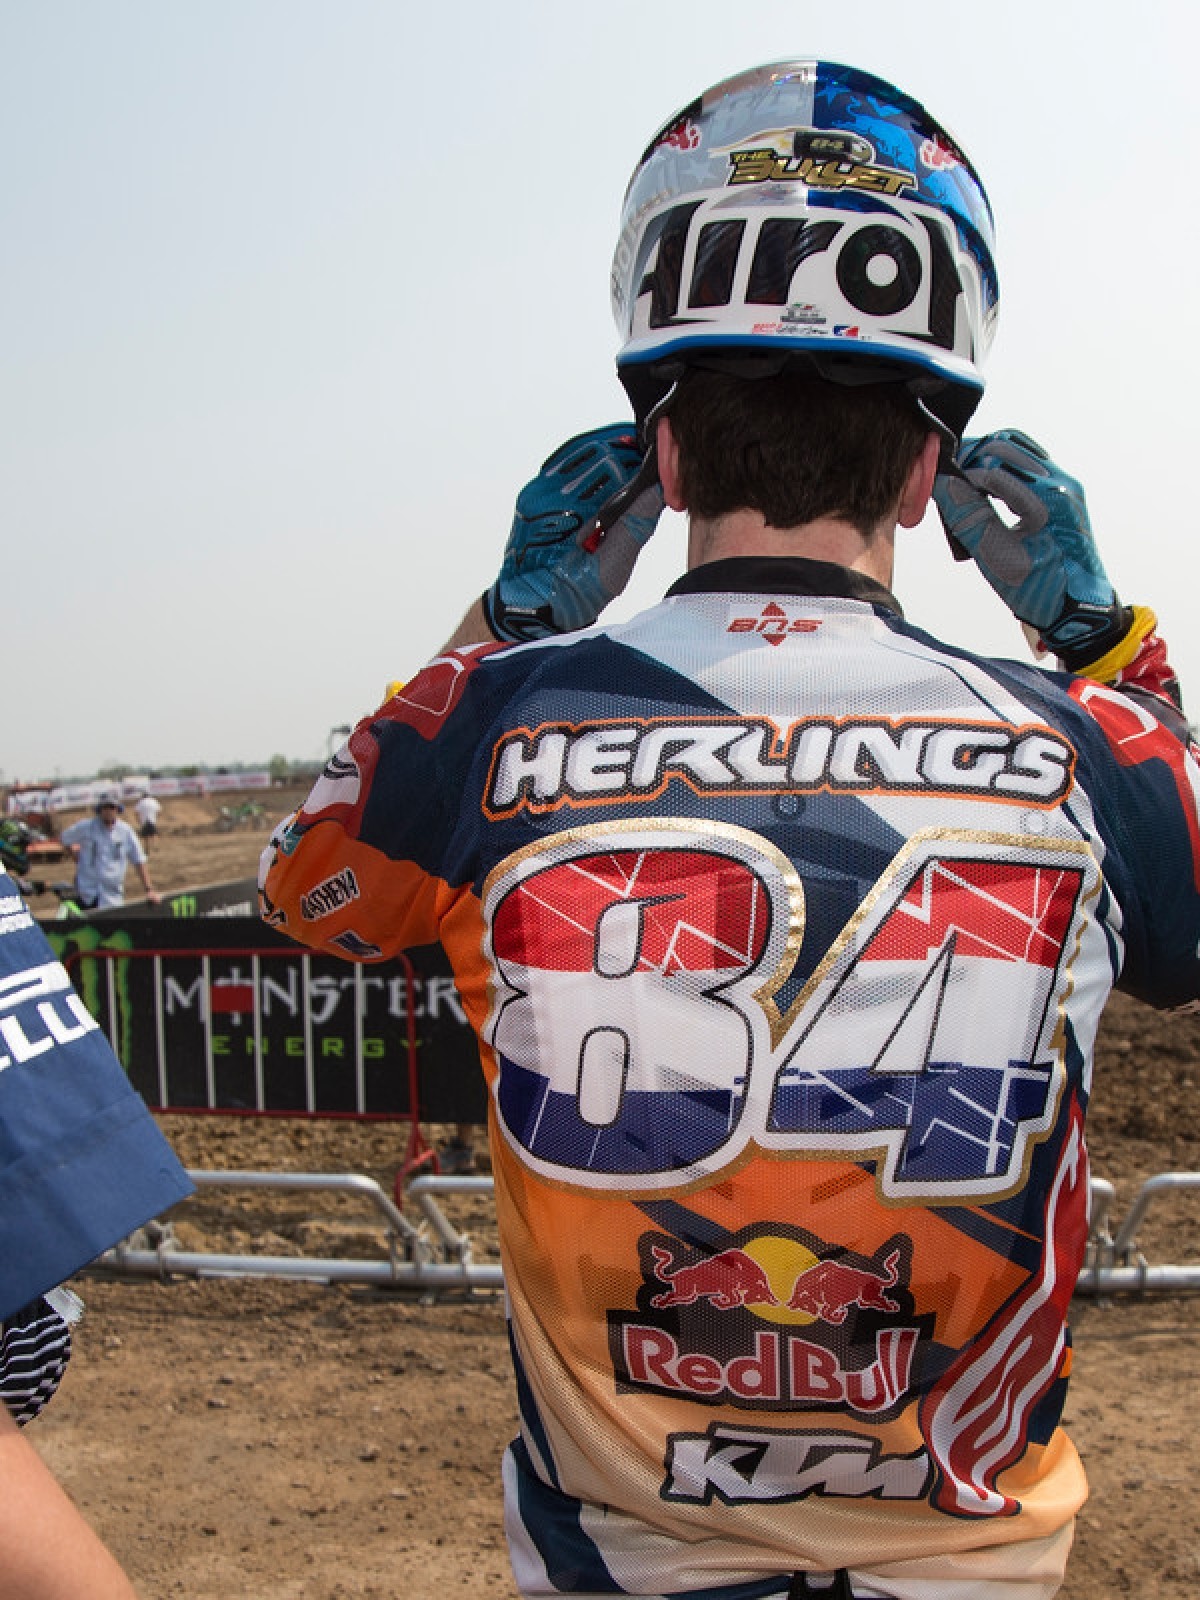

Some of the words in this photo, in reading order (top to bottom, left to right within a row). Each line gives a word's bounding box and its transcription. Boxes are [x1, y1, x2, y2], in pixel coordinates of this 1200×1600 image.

[730, 157, 915, 195] BULLET
[488, 719, 1074, 814] HERLINGS
[164, 965, 470, 1026] MNSTER
[486, 828, 1094, 1198] 84
[622, 1323, 782, 1400] Red
[789, 1327, 921, 1414] Bull
[667, 1425, 931, 1501] KTM
